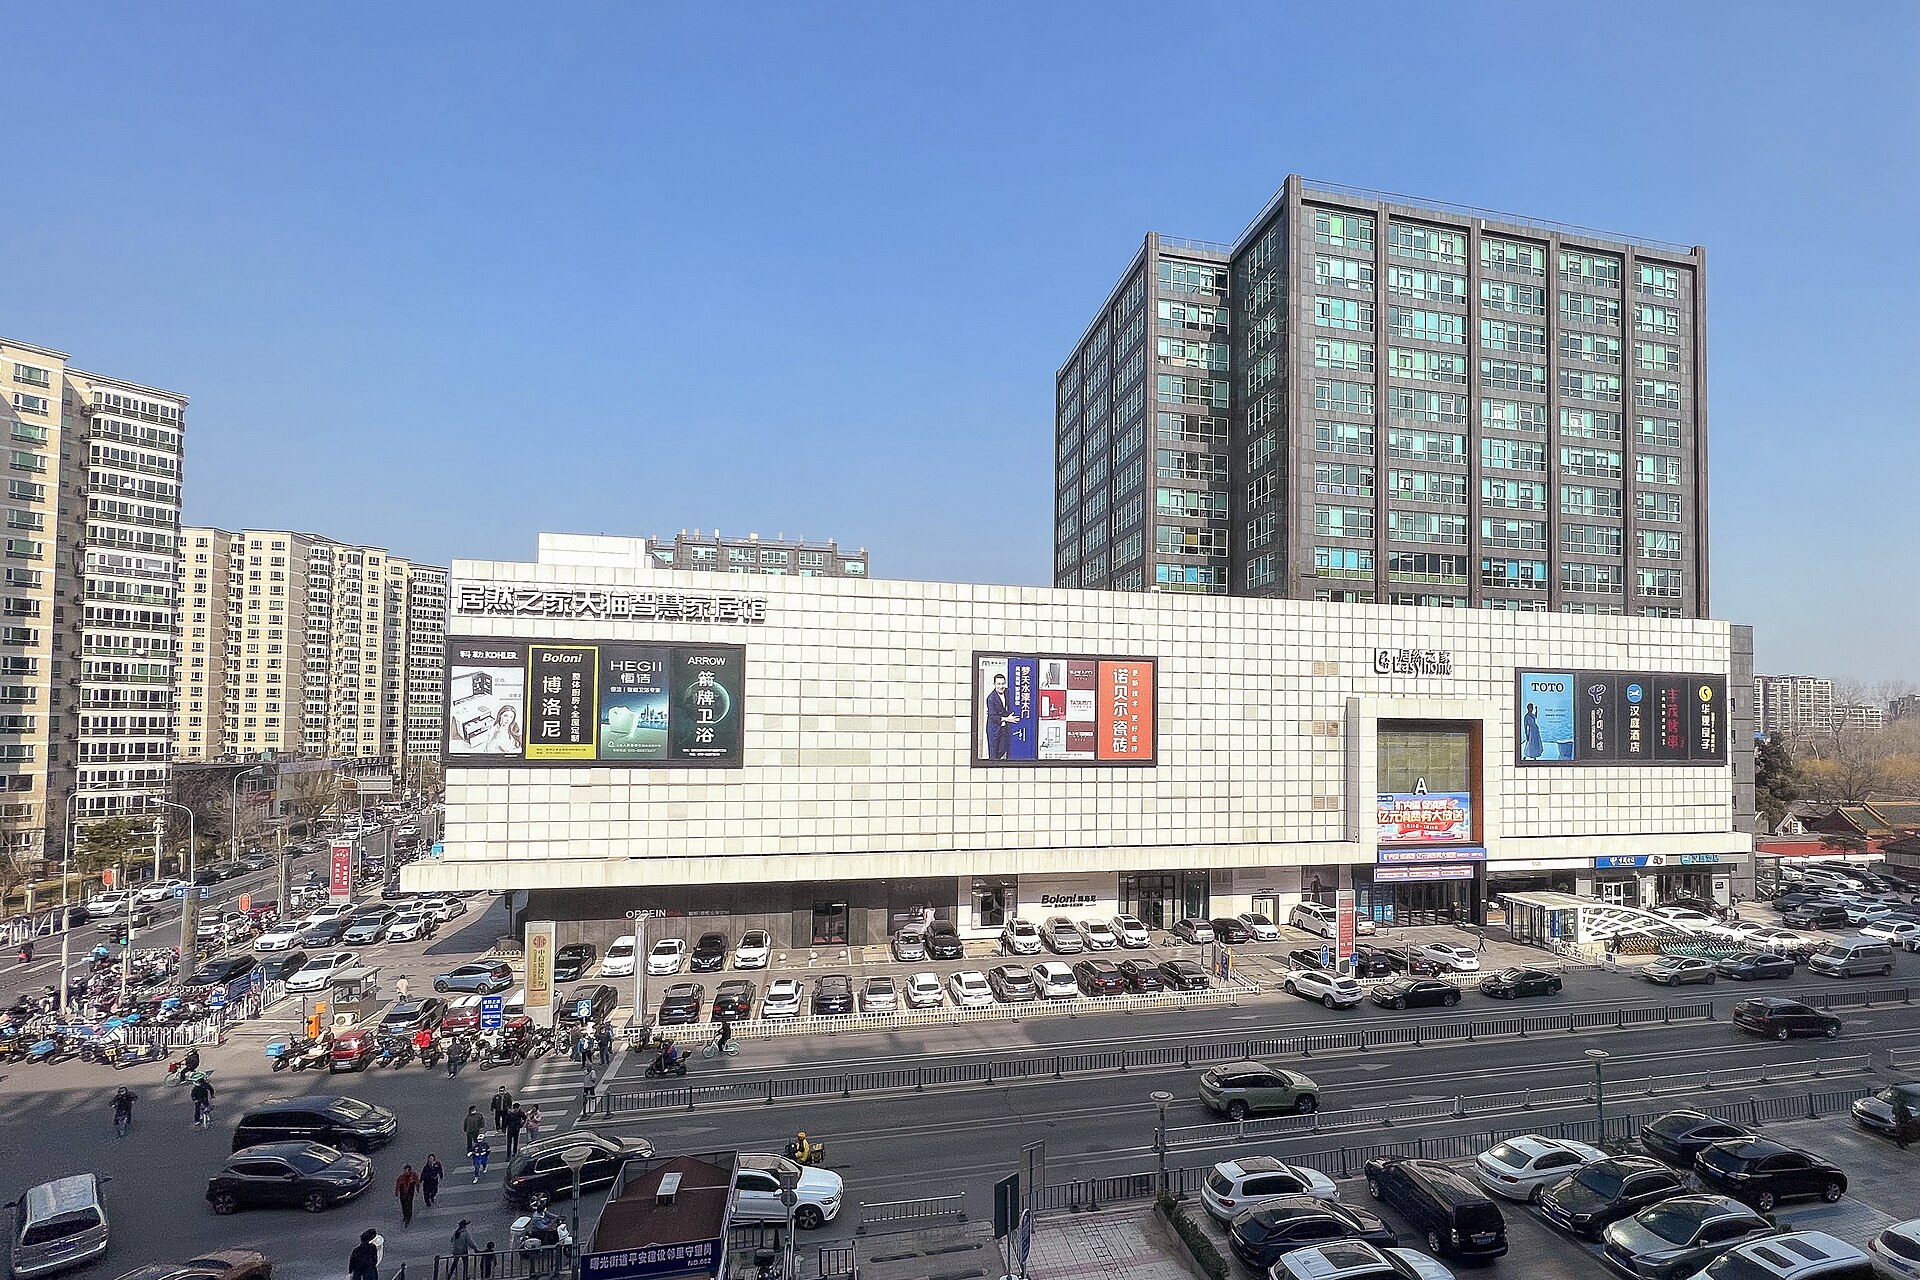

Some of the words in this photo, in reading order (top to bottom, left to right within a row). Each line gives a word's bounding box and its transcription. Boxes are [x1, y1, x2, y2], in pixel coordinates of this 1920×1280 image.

[457, 584, 768, 624] 居然之家天猫智慧家居馆
[484, 651, 518, 660] KOHLER
[542, 653, 582, 663] Boloni
[610, 660, 662, 672] HEGII
[687, 656, 726, 666] ARROW
[620, 672, 651, 684] 恒洁
[1531, 682, 1564, 692] TOTO
[541, 675, 562, 738] 博洛尼
[695, 670, 716, 743] 箭牌卫浴
[1112, 668, 1128, 753] 诺贝尔瓷砖
[1630, 706, 1640, 752] 汉庭酒店
[1701, 704, 1710, 750] 华夏良子
[1413, 777, 1428, 796] A
[589, 1243, 712, 1271] 曙光街道平安建设邻里守望岗
